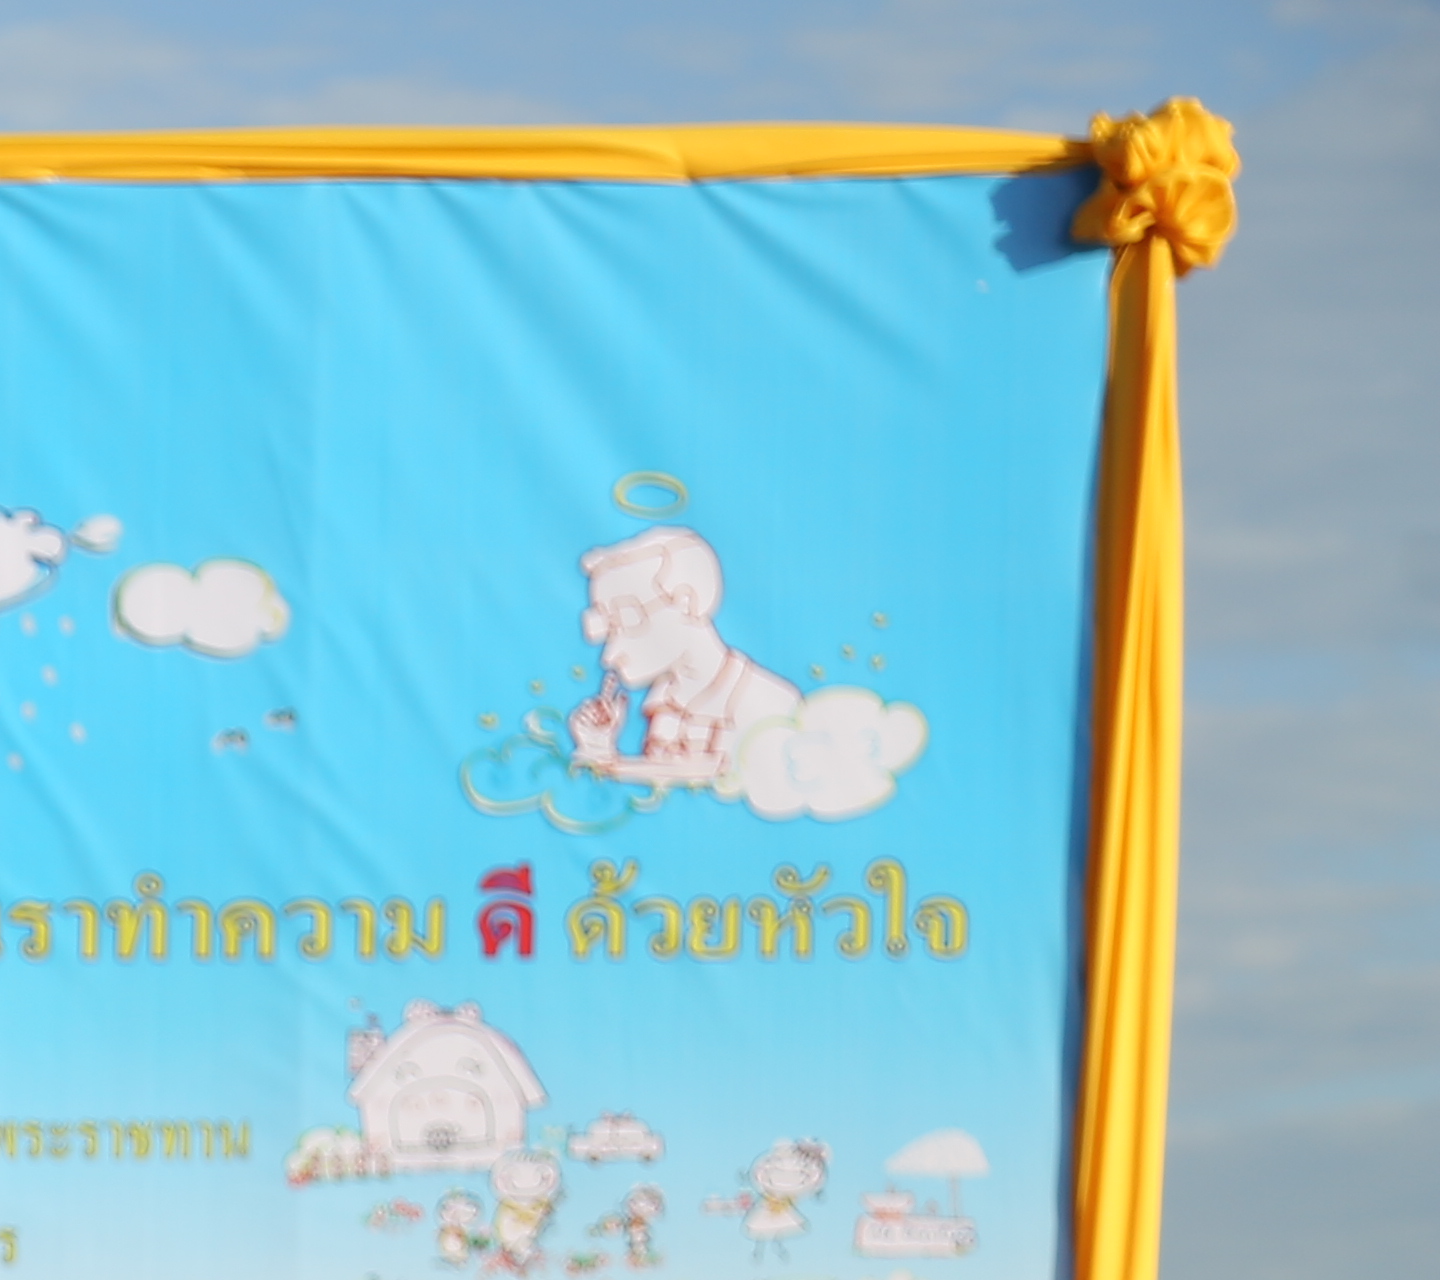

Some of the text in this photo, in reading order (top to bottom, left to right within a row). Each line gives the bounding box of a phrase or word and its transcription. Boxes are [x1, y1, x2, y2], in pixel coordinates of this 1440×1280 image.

[478, 862, 534, 960] ดี
[565, 858, 970, 960] ด้วยหัวใจ
